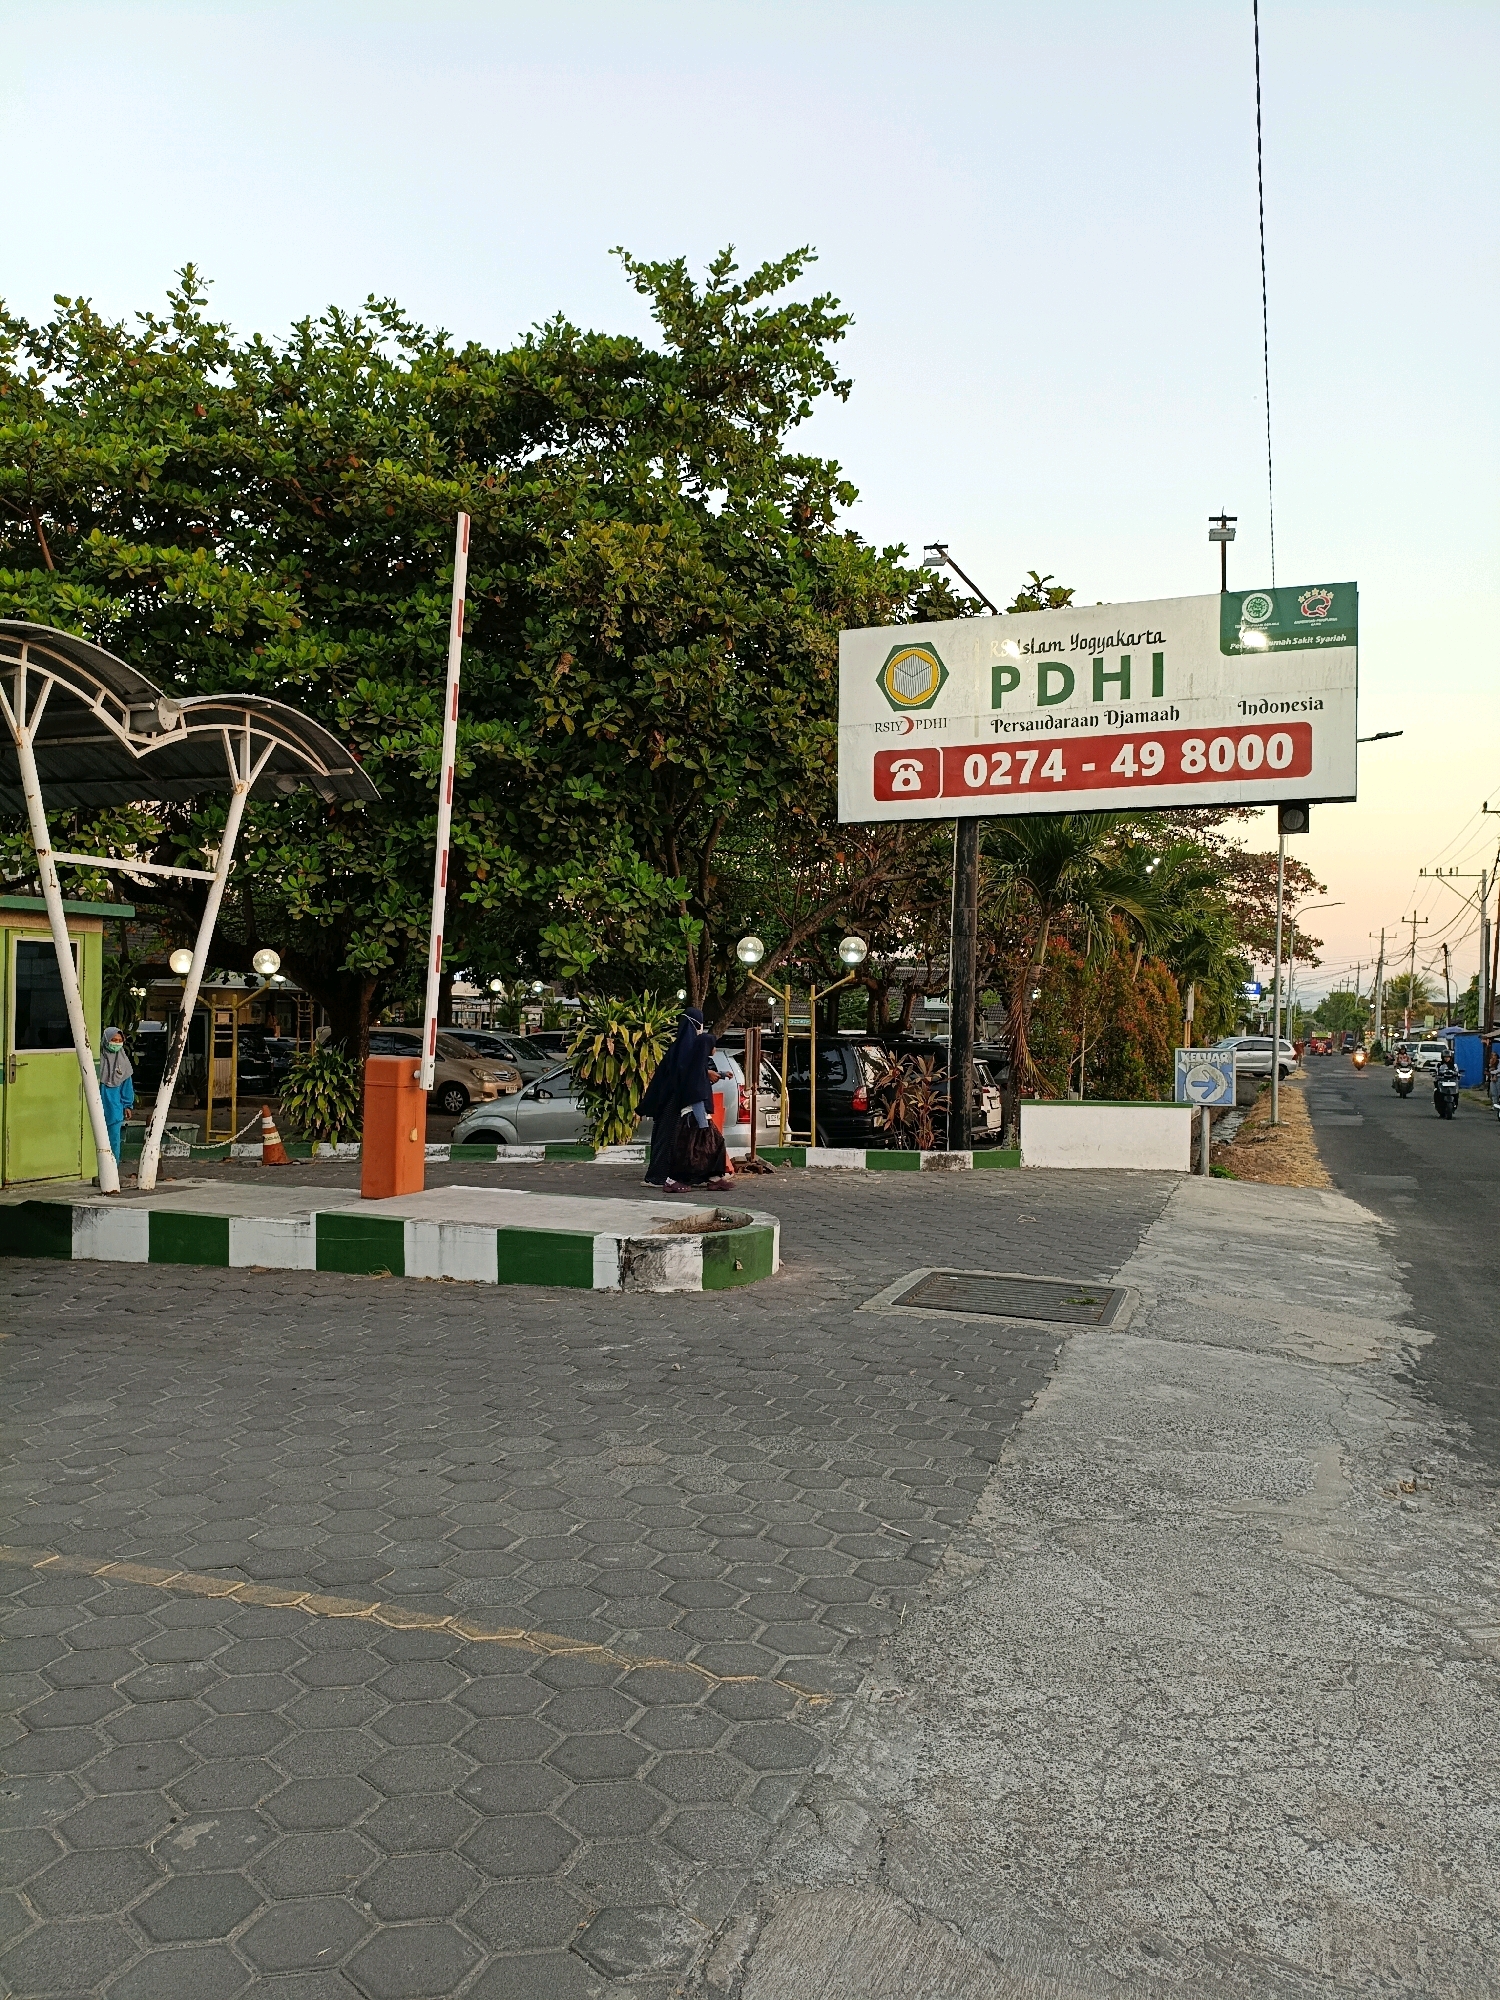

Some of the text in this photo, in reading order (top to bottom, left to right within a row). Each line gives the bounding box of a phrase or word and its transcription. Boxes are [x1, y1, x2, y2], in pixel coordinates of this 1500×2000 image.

[1017, 637, 1066, 655] Islam
[1069, 629, 1167, 656] Yogyakarta
[1268, 634, 1347, 646] umah Sakit Syariah
[991, 652, 1164, 710] PDHI
[875, 717, 947, 733] RSIY PDHI
[990, 714, 1099, 734] Persaudaraan
[1104, 705, 1180, 729] Djamaah
[1237, 696, 1325, 717] Indonesia
[963, 732, 1294, 788] 0274 - 49 8000
